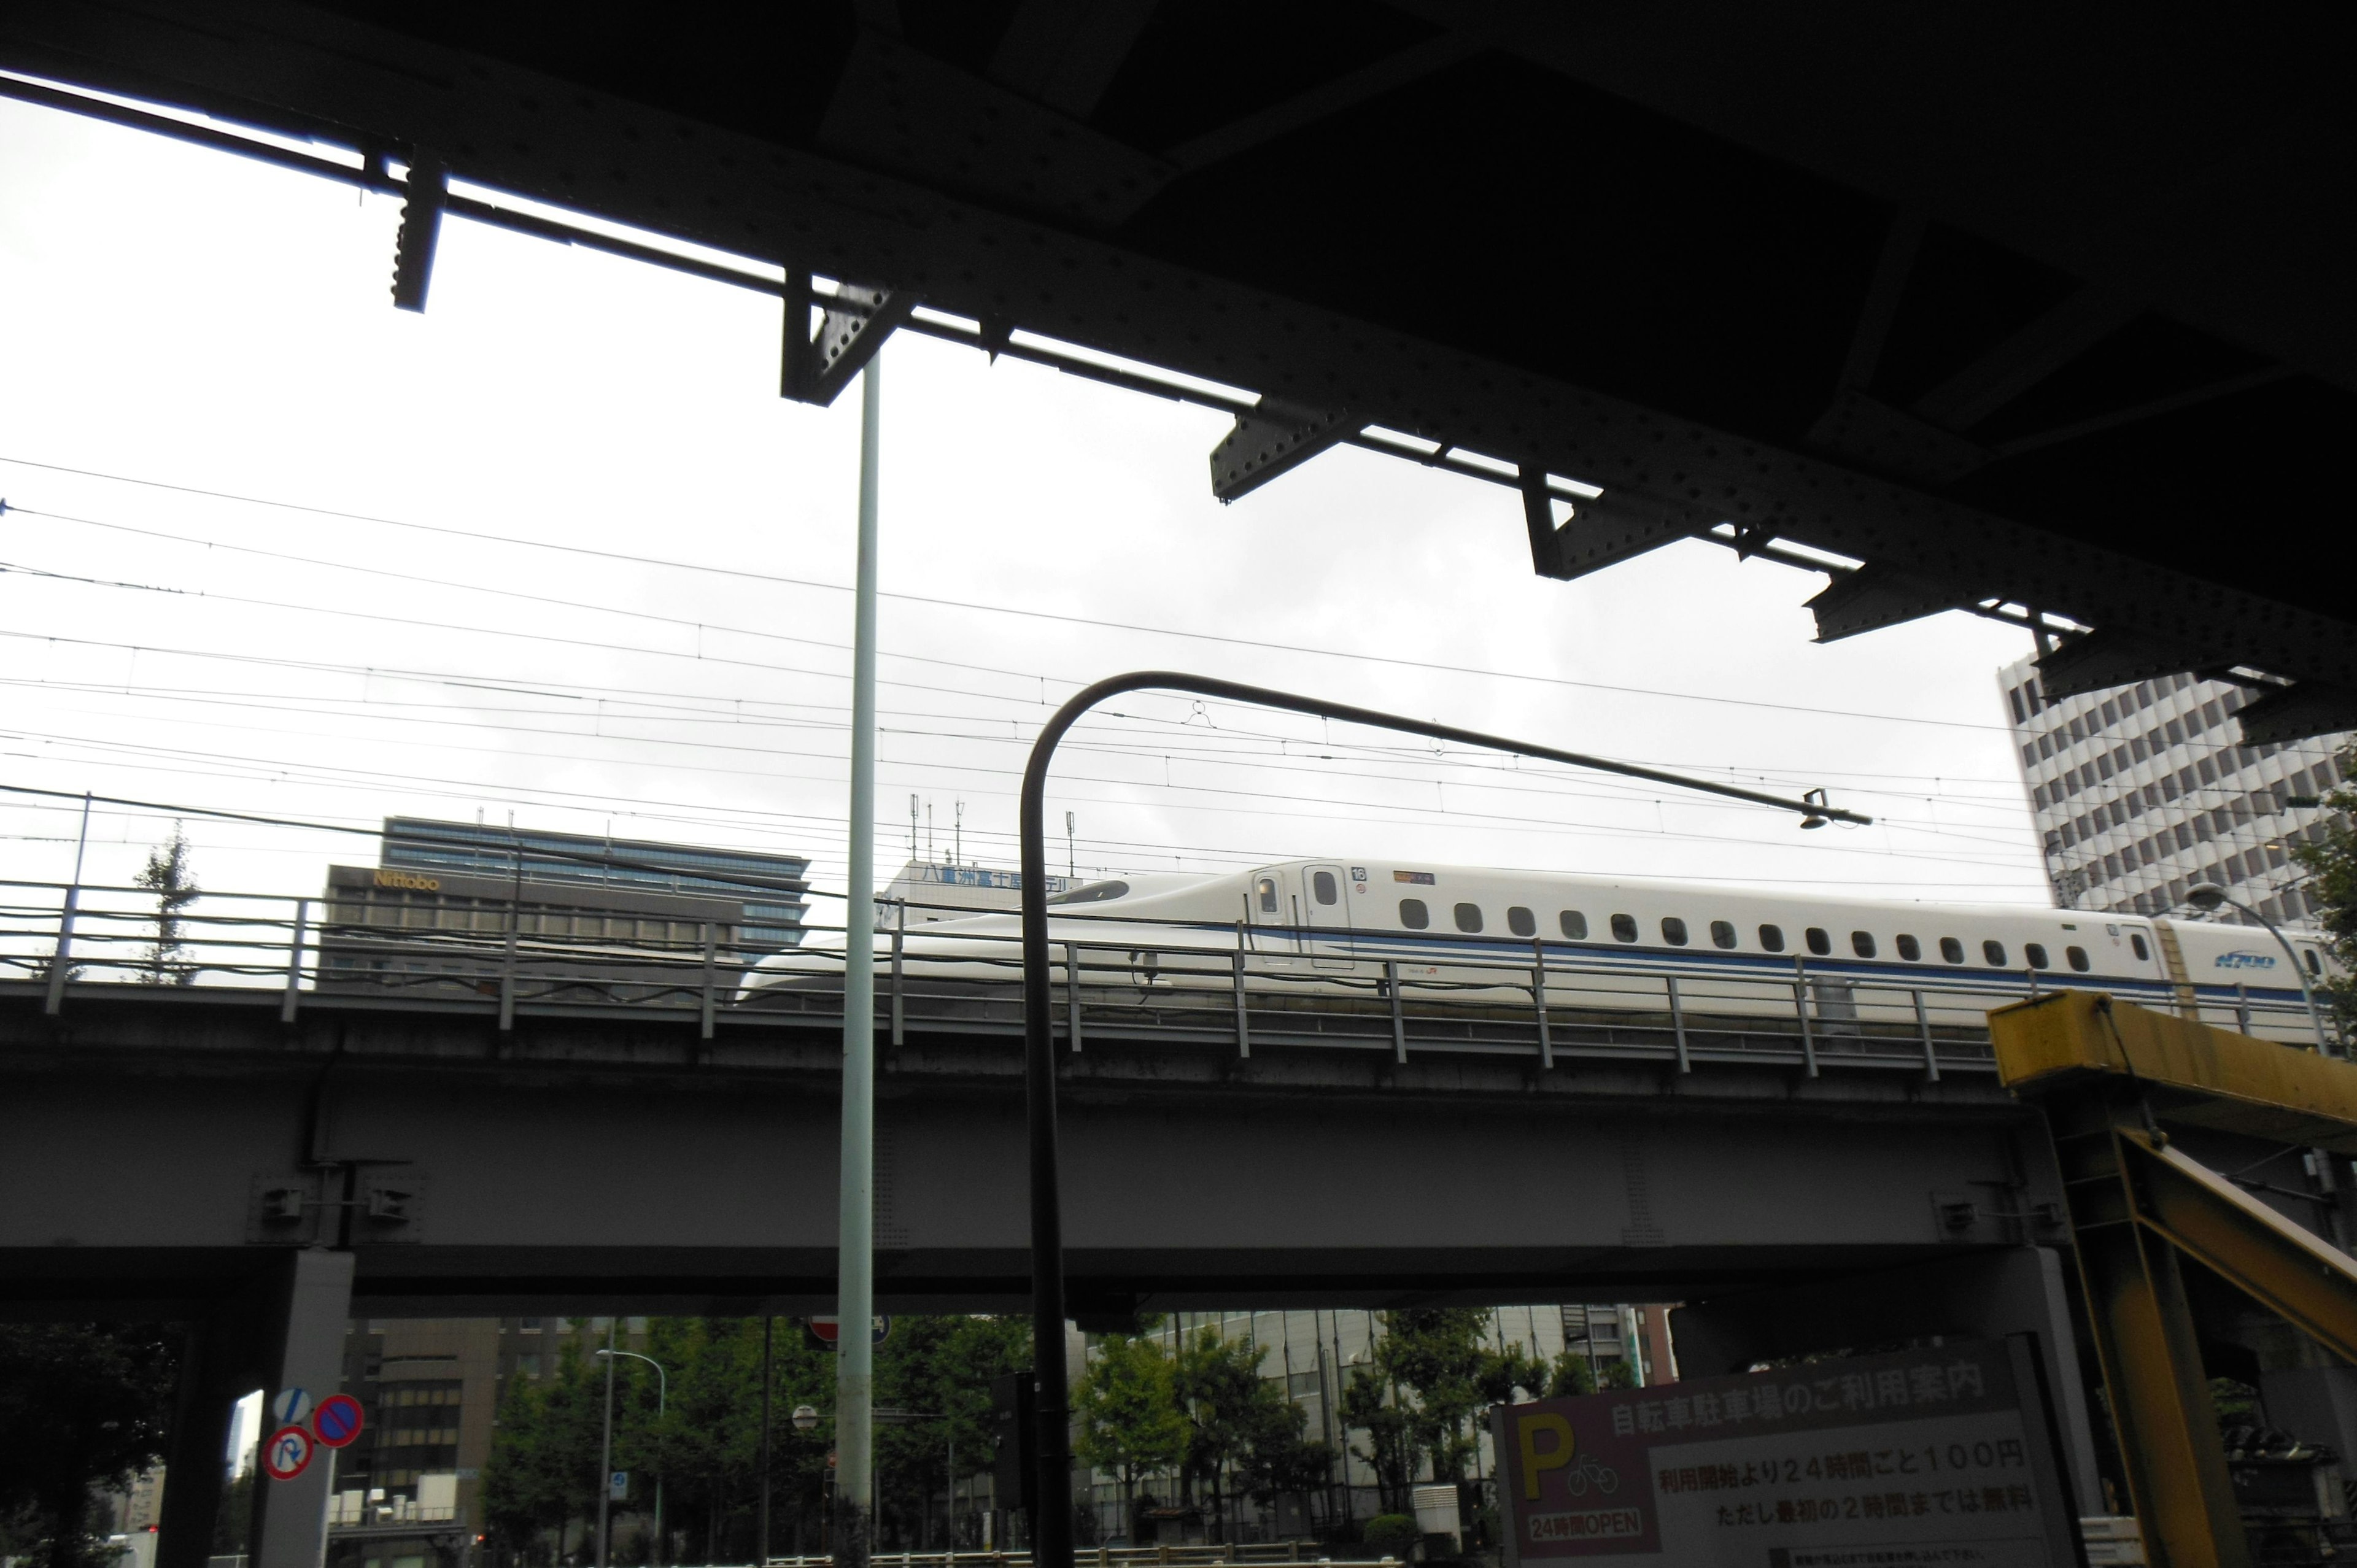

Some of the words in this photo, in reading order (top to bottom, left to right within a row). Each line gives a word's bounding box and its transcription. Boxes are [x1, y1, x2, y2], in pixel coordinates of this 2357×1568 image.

[373, 870, 439, 890] Nittobo
[923, 864, 1067, 891] 八重洲富士屋テル
[1352, 867, 1366, 880] 16
[1612, 1361, 1984, 1437] 自転車駐車場のご利用案内
[1517, 1412, 1575, 1500] P
[1532, 1512, 1639, 1538] 24時間OPEN
